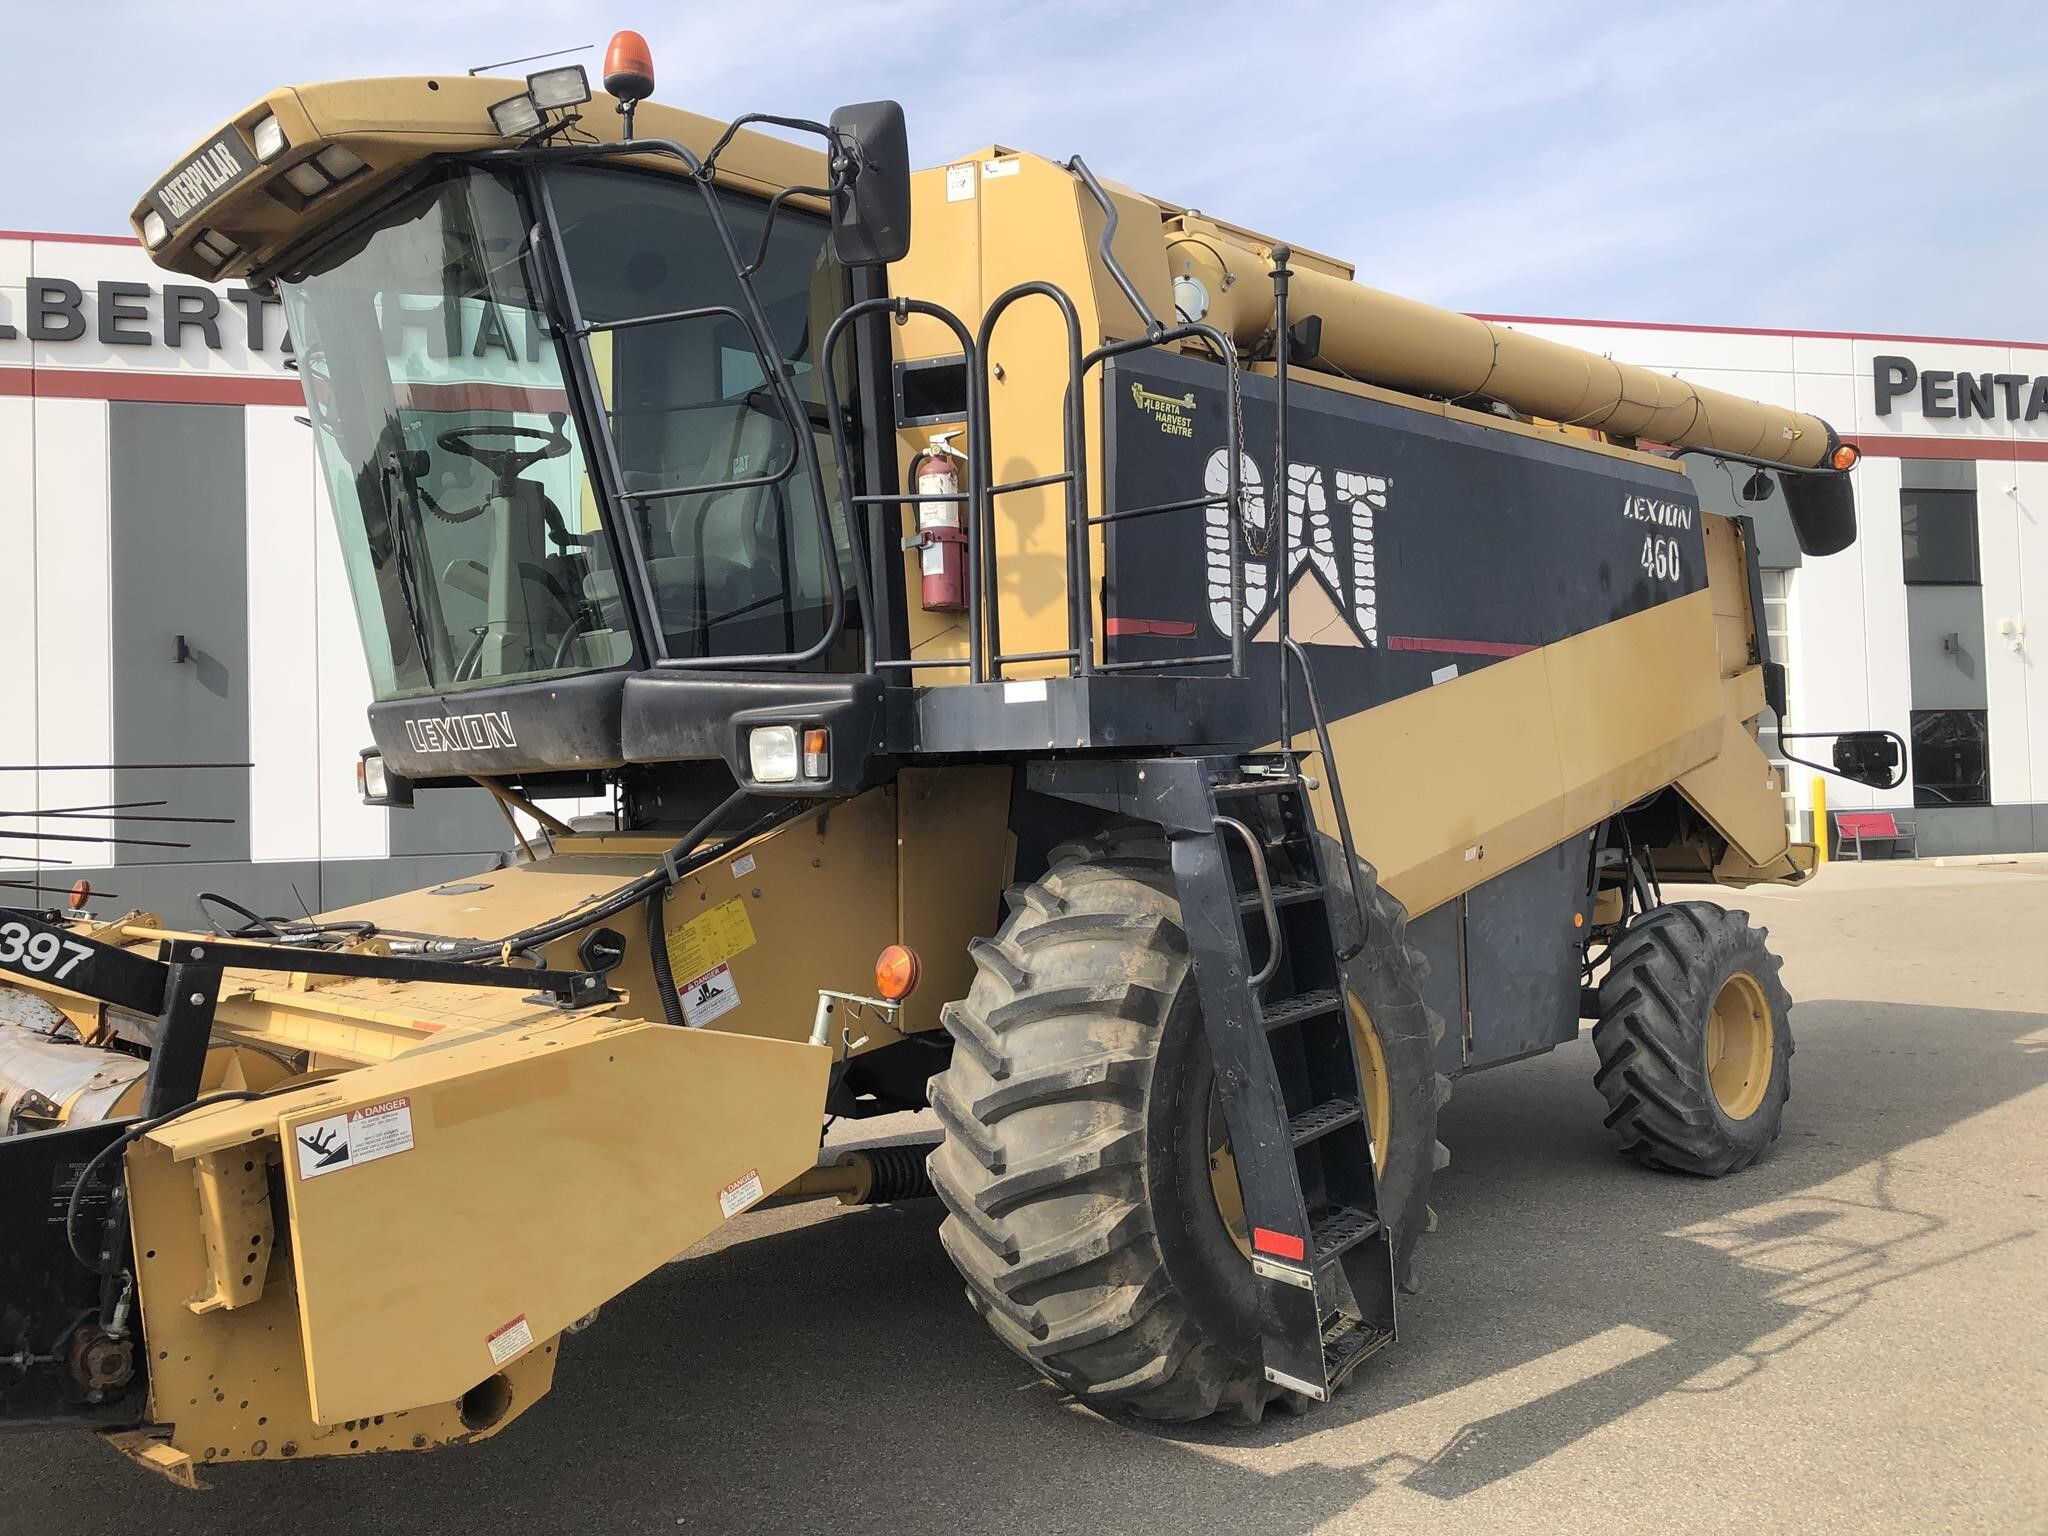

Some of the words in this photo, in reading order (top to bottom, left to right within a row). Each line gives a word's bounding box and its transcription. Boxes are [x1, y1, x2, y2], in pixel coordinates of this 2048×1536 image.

[158, 141, 242, 219] CATERPILLAR
[1144, 399, 1180, 415] ALBERTA
[1155, 411, 1192, 428] HARVEST
[1161, 422, 1193, 438] CENTRE
[733, 454, 750, 474] CAT
[1623, 495, 1691, 529] LEXION
[1204, 449, 1387, 648] CAT
[1641, 536, 1681, 581] 460
[405, 711, 518, 753] LEXION
[0, 921, 96, 980] 397
[694, 968, 721, 987] DANGER
[365, 1099, 407, 1116] DANGER
[727, 1170, 757, 1192] DANGER
